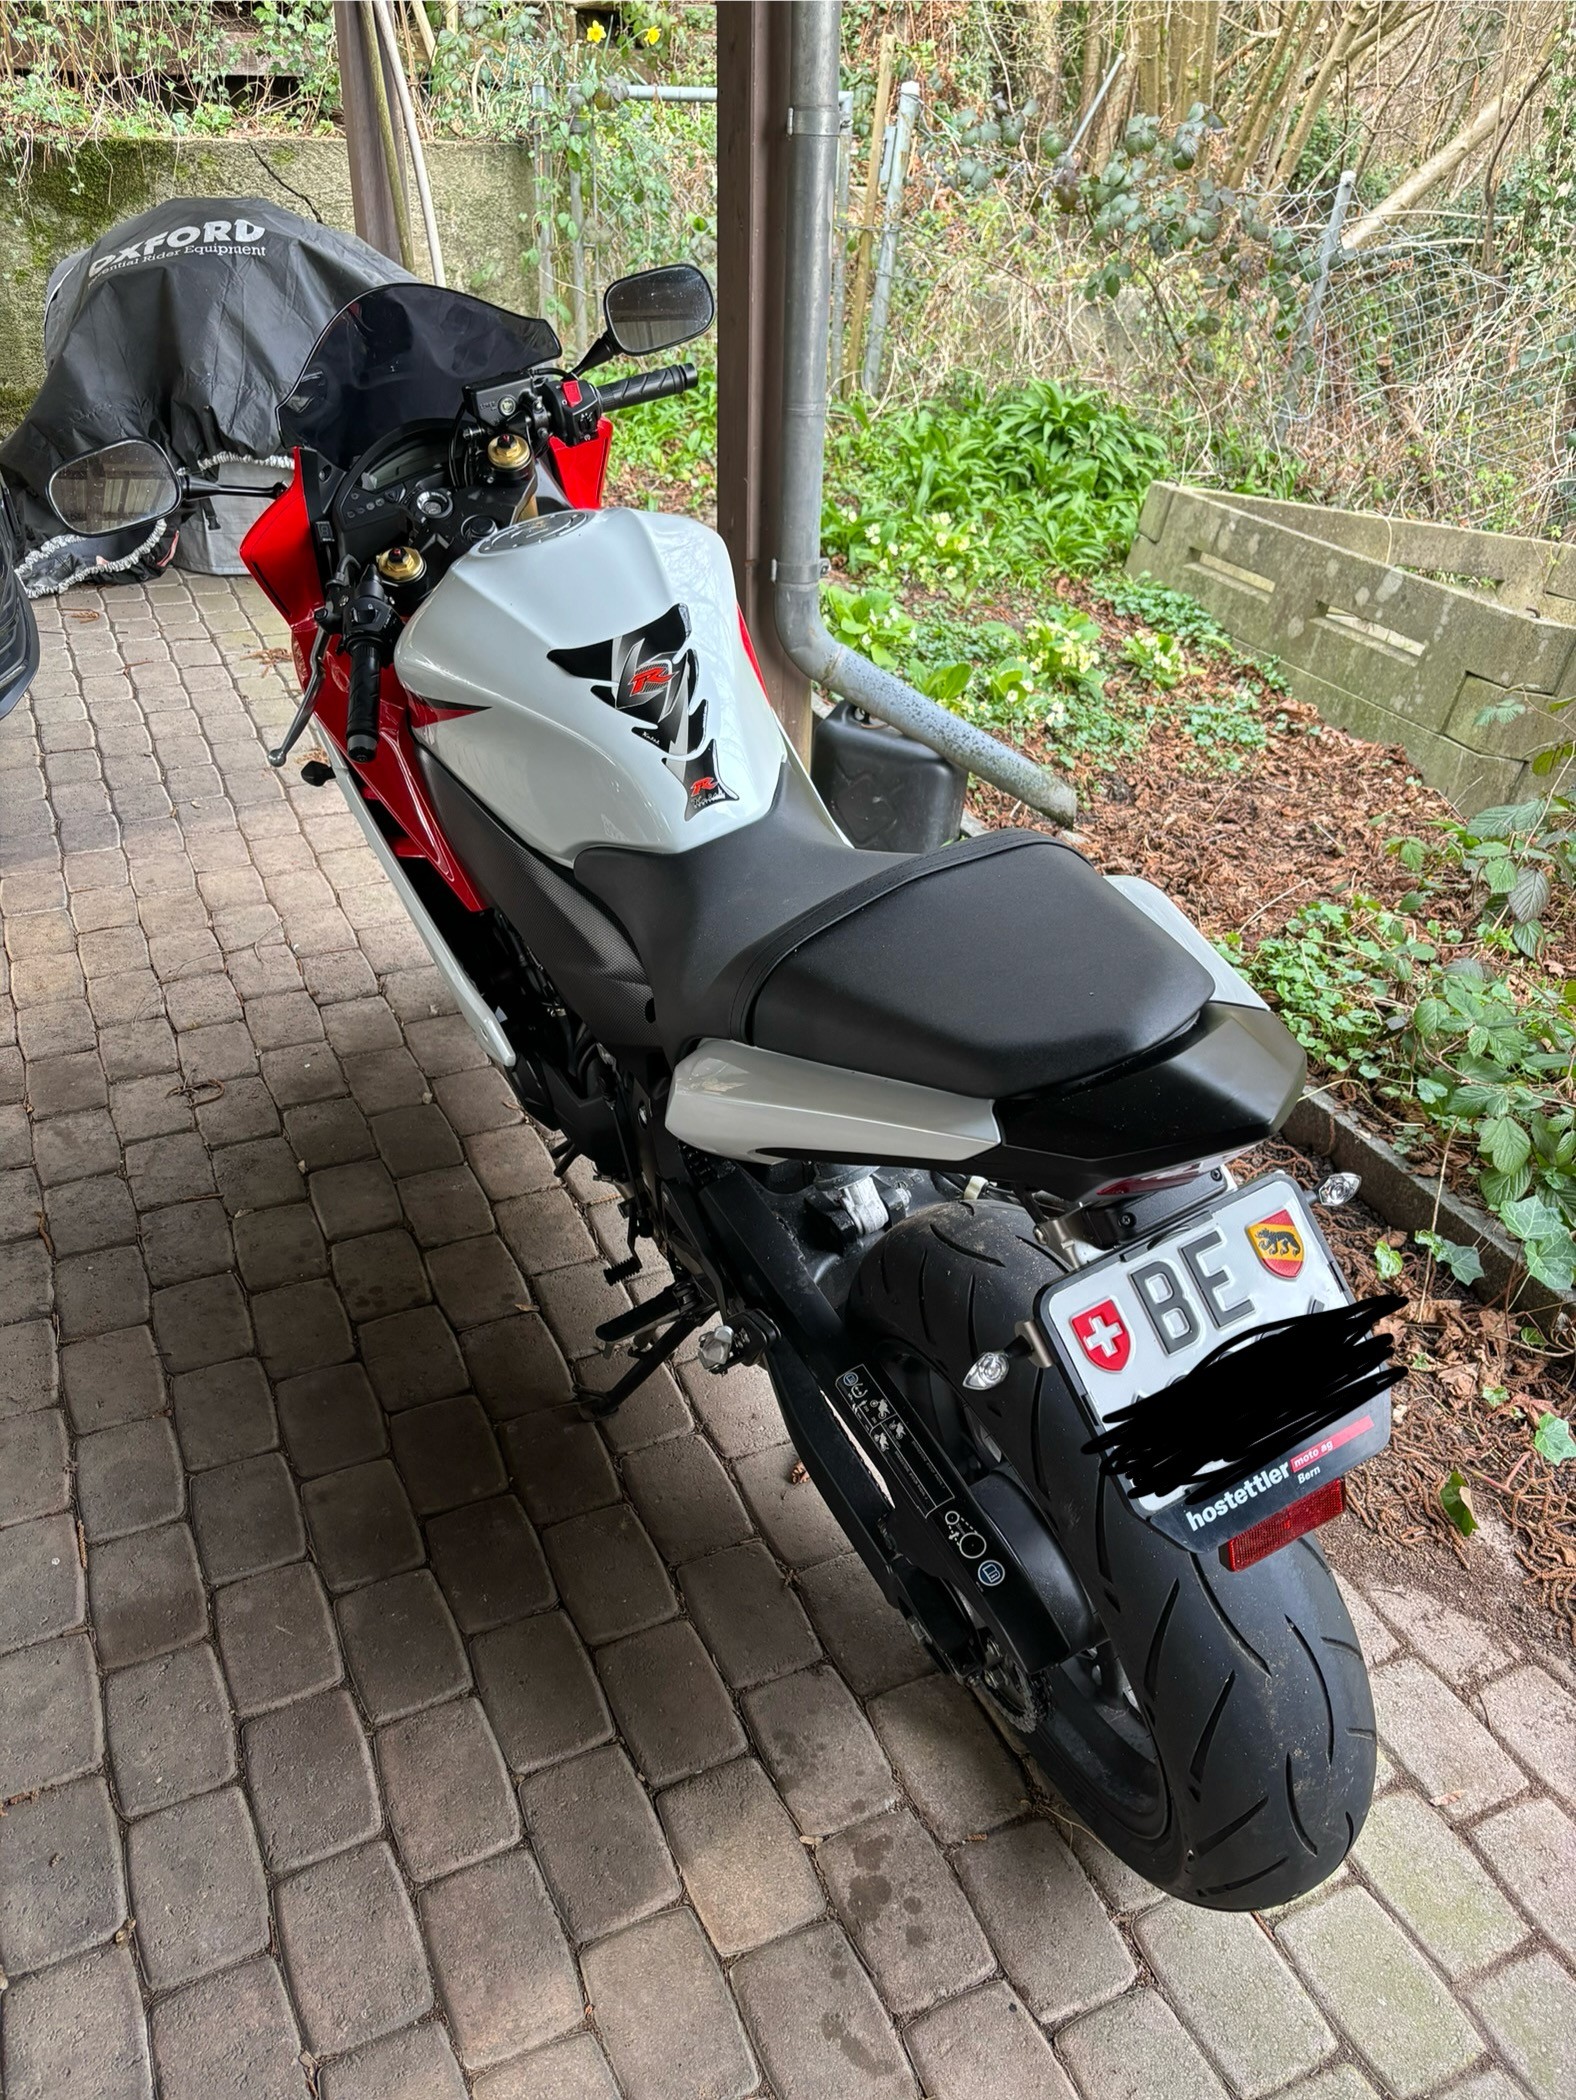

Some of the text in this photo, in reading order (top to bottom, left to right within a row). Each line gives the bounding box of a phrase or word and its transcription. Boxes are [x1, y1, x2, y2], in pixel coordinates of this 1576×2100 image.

[88, 219, 265, 278] OXFORD
[142, 249, 181, 263] Rider
[184, 244, 266, 257] Equipment
[1129, 1228, 1256, 1355] BE
[1293, 1440, 1334, 1468] moto ag
[1297, 1465, 1321, 1485] Bern
[1185, 1461, 1291, 1532] hostettler
